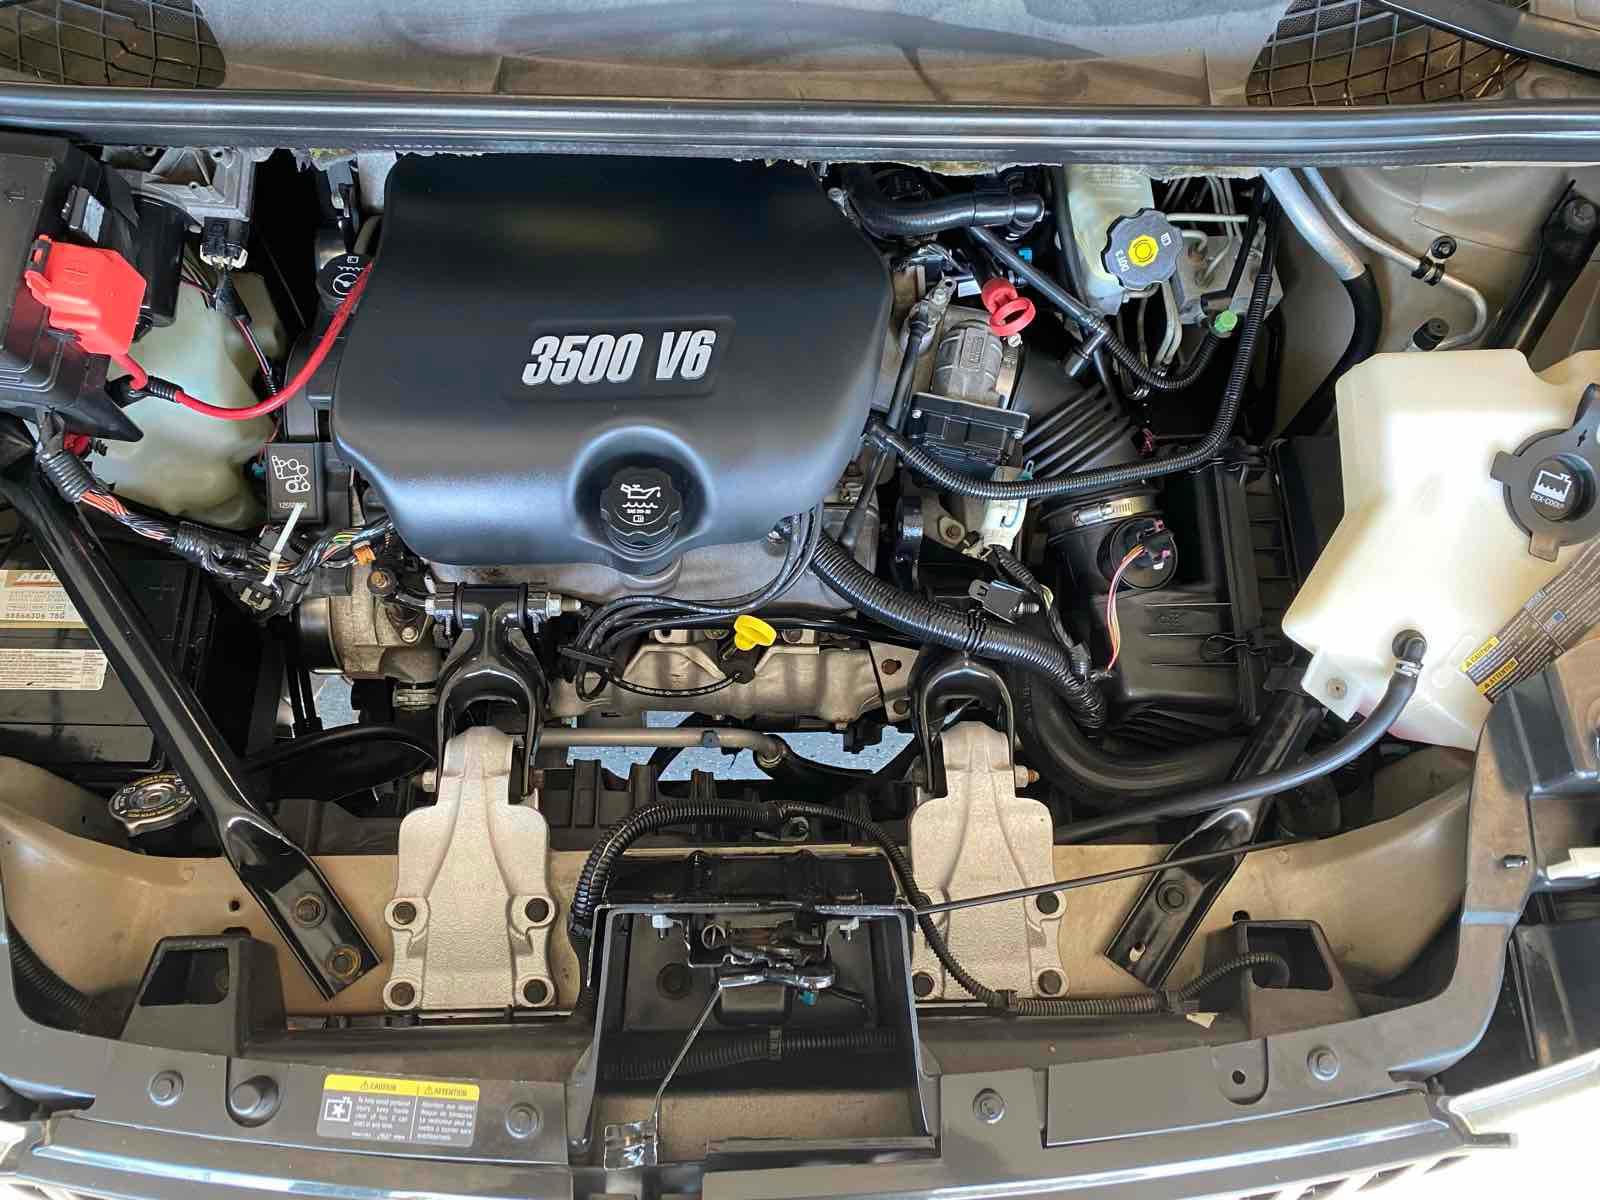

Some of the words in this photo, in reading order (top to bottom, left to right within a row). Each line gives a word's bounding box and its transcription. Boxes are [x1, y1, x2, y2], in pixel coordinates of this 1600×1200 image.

[522, 333, 644, 385] 3500
[656, 329, 717, 381] V6
[370, 1083, 397, 1092] CAUTION
[433, 1087, 468, 1097] ATTENTION
